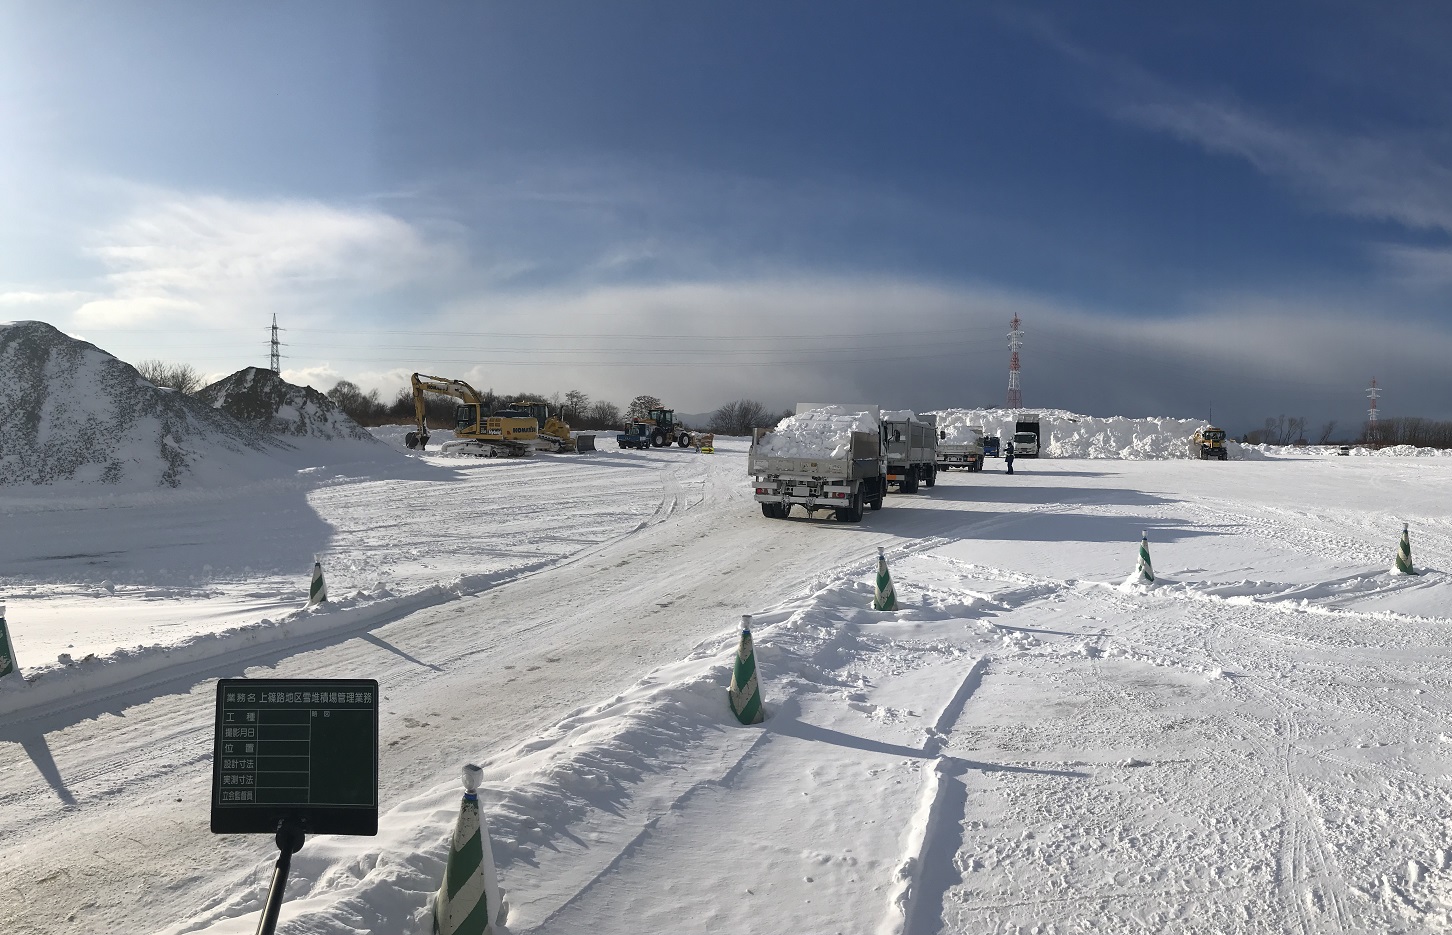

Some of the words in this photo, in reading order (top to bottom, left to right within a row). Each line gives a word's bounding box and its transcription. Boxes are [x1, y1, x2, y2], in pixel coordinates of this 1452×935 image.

[226, 693, 256, 703] 業務名
[226, 713, 255, 722] 工種
[225, 728, 255, 738] 撮影月日
[224, 743, 254, 753] 位置
[223, 759, 254, 769] 設計寸法
[223, 775, 254, 785] 実測寸法
[222, 791, 253, 801] 立会監督員
